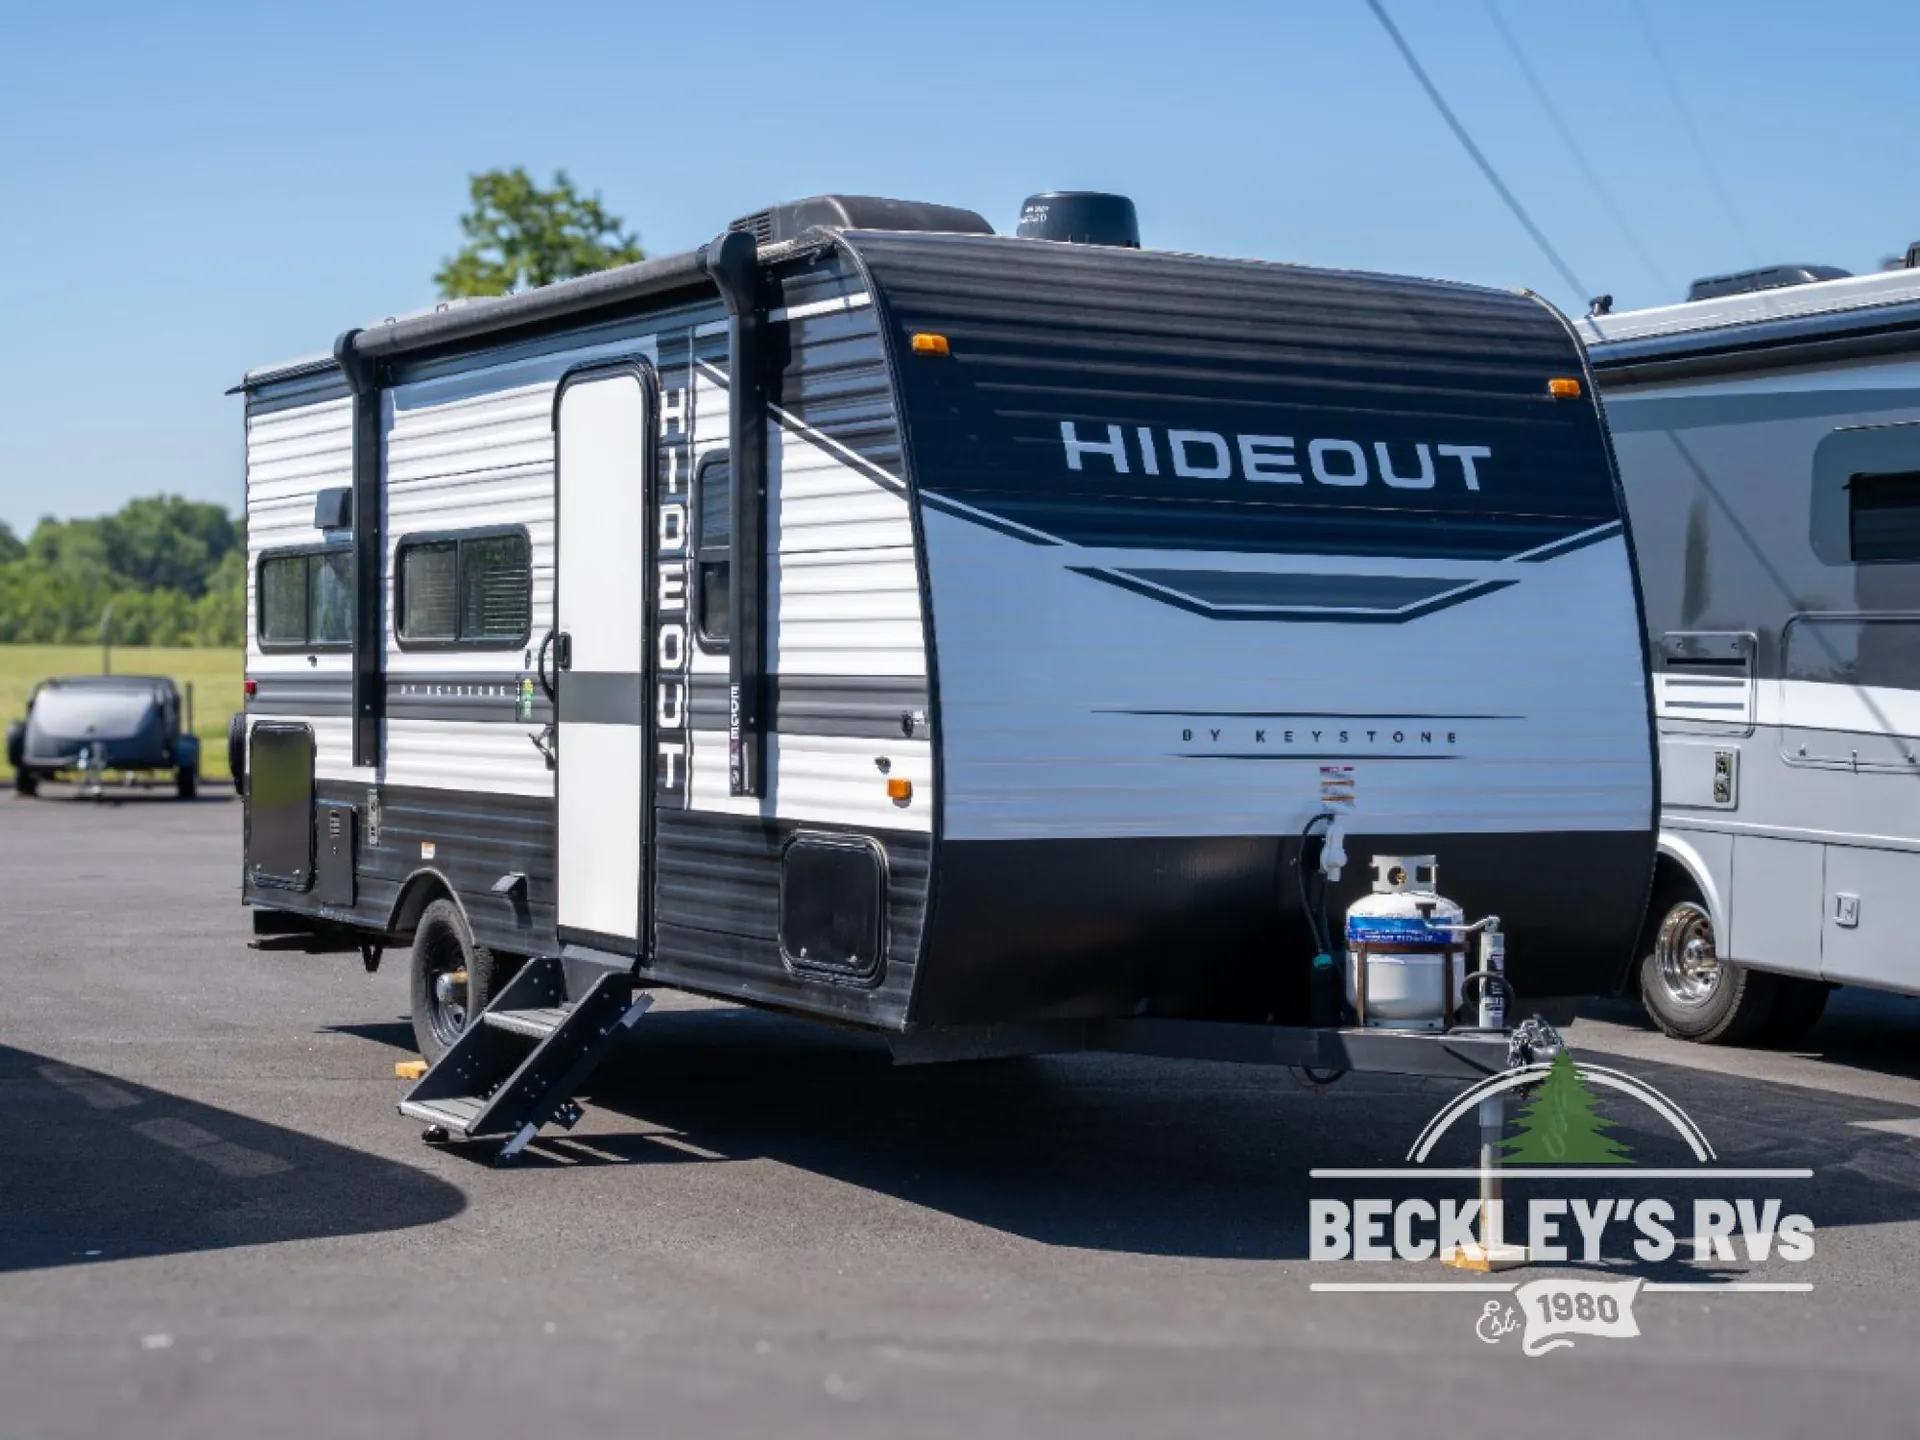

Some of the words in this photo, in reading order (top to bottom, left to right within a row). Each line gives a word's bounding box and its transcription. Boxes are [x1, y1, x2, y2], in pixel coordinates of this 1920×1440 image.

[1060, 421, 1492, 491] HIDEOUT
[658, 387, 685, 789] HIDEOUT
[730, 685, 740, 740] EDGE
[1182, 728, 1221, 742] BY
[1255, 730, 1457, 744] KEYSTONE
